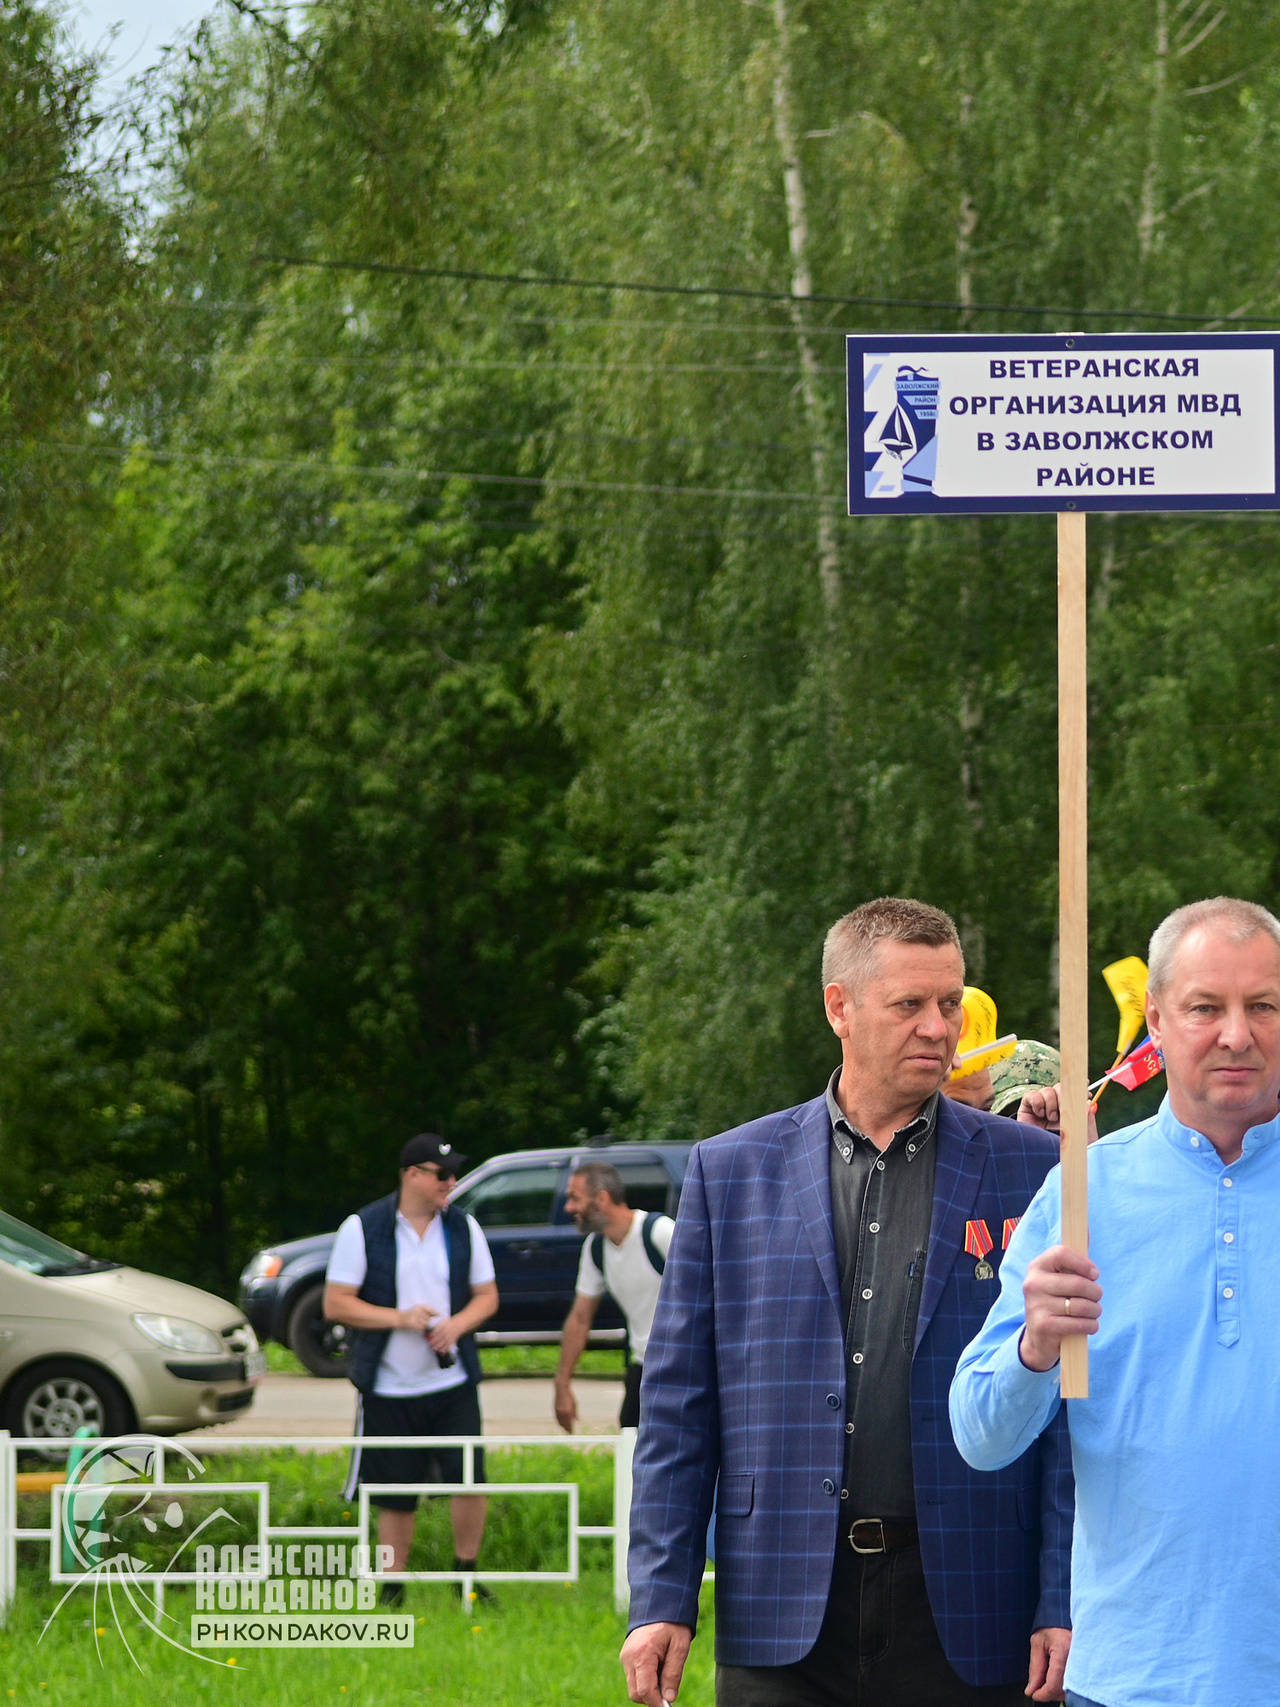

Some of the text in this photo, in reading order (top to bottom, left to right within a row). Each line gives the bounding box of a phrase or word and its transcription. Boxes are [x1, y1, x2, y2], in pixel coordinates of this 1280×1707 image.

[989, 358, 1199, 379] ВЕТЕРАНСКАЯ
[896, 382, 940, 390] ЗАВОЛЖСКИЙ
[914, 395, 936, 404] РАЙОН
[949, 393, 1242, 418] ОРГАНИЗАЦИЯ МВД
[977, 430, 1213, 451] В ЗАВОЛЖСКОМ
[1036, 462, 1155, 487] РАЙОНЕ
